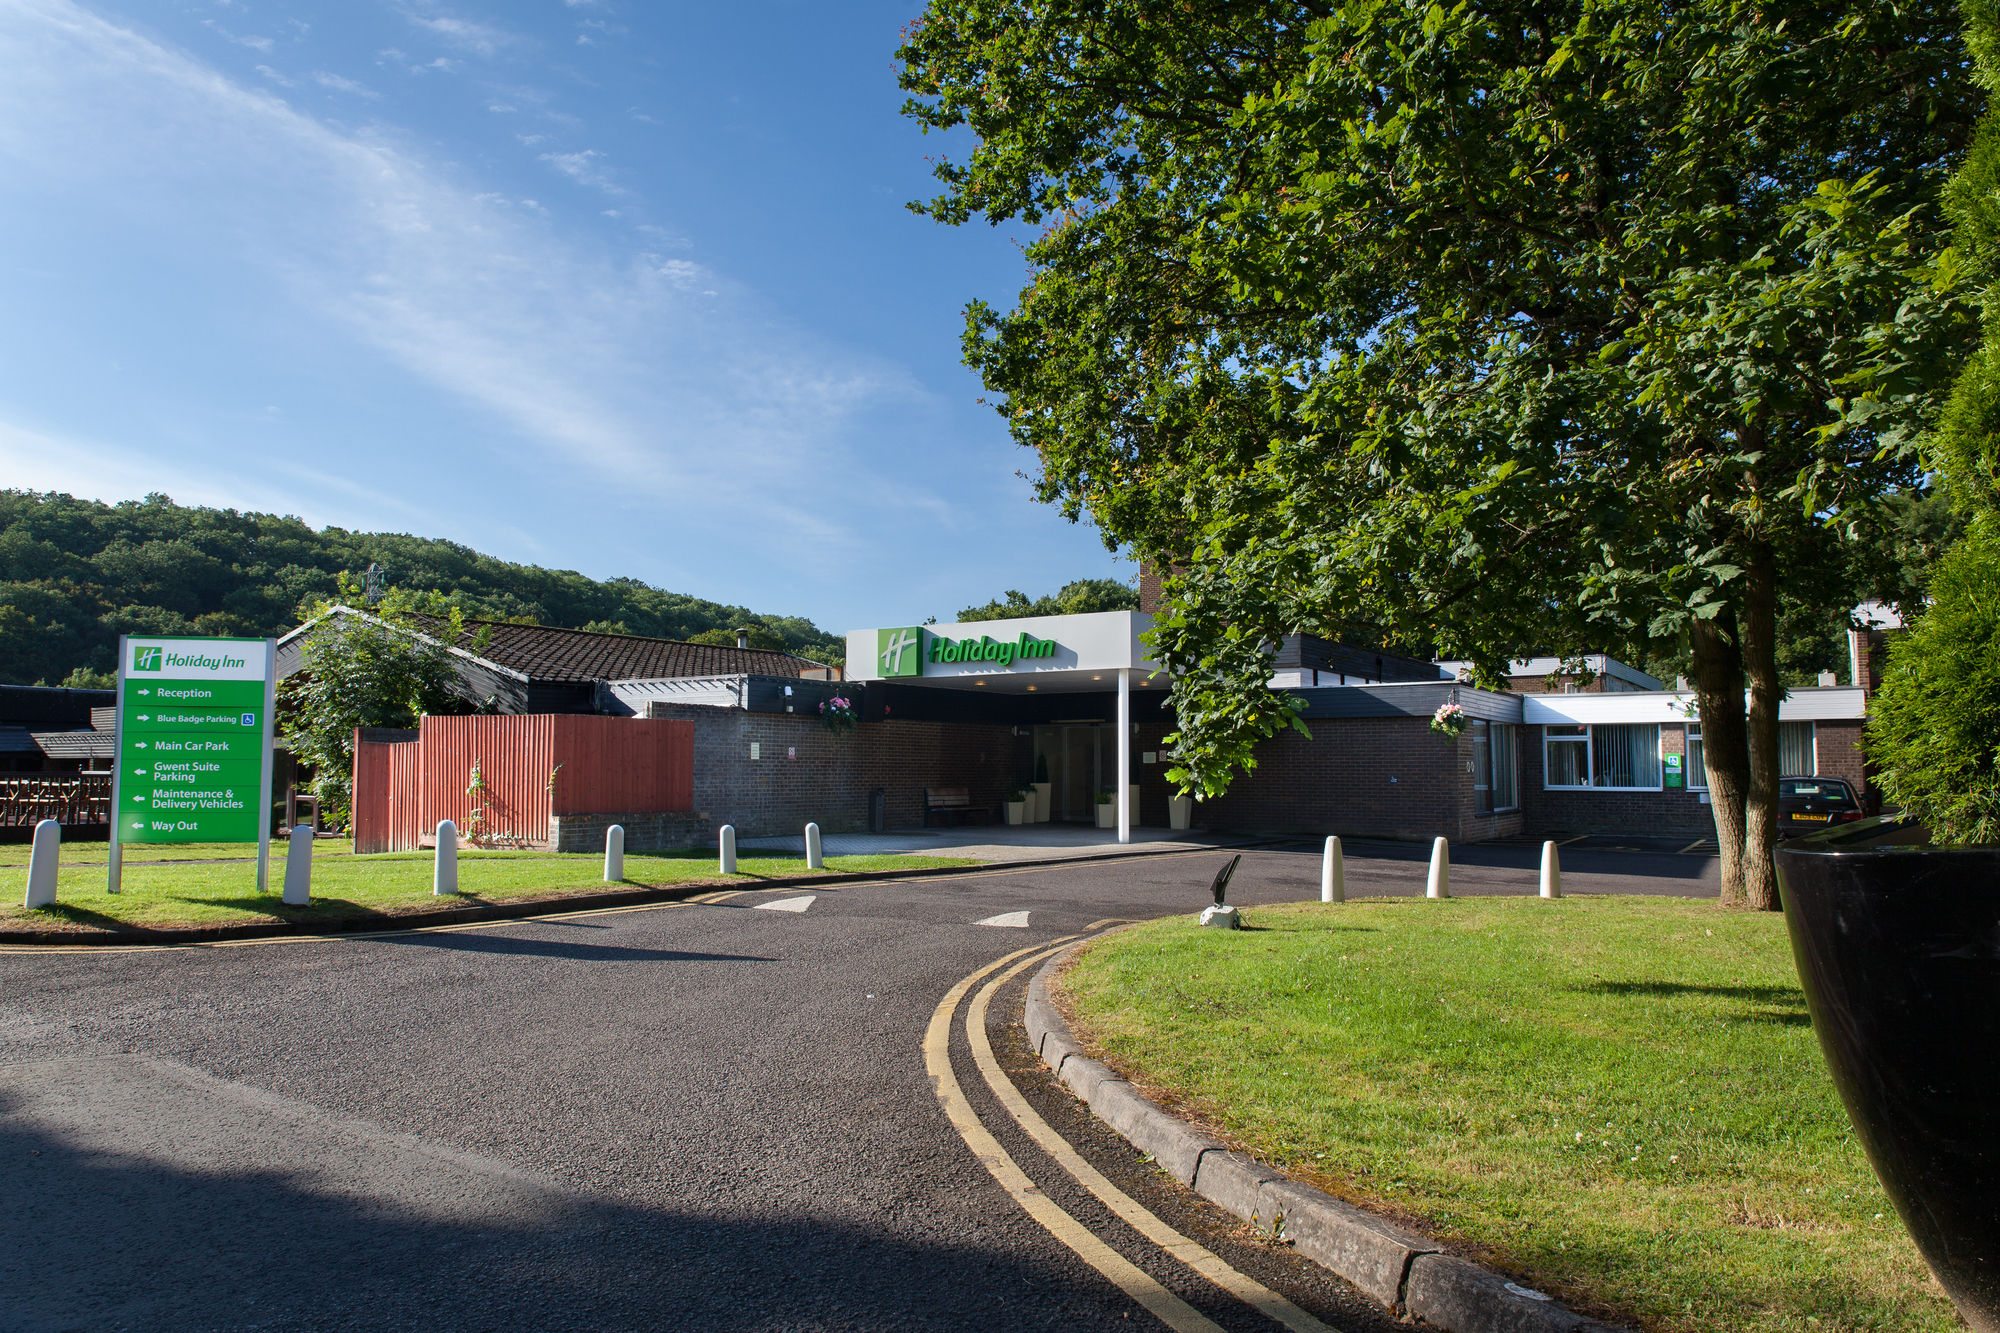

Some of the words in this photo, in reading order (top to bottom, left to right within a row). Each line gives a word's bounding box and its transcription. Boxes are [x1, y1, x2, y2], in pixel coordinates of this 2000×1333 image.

[929, 635, 1017, 667] Holiday
[1017, 632, 1056, 659] Inn
[165, 653, 221, 670] Holiday
[223, 655, 245, 668] Inn
[157, 688, 212, 699] Reception
[157, 714, 176, 723] Blue
[178, 715, 205, 725] Badge
[206, 715, 237, 725] Parking
[155, 741, 182, 750] Main
[185, 741, 203, 751] Car
[205, 742, 230, 751] Park
[154, 762, 190, 771] Gwent
[192, 762, 220, 771] Suite
[154, 772, 196, 783] Parking
[153, 789, 223, 798] Maintenance
[225, 789, 234, 798] &
[152, 799, 198, 810] Delivery
[200, 799, 244, 809] Vehicles
[152, 821, 175, 832] Way
[177, 821, 198, 830] Out
